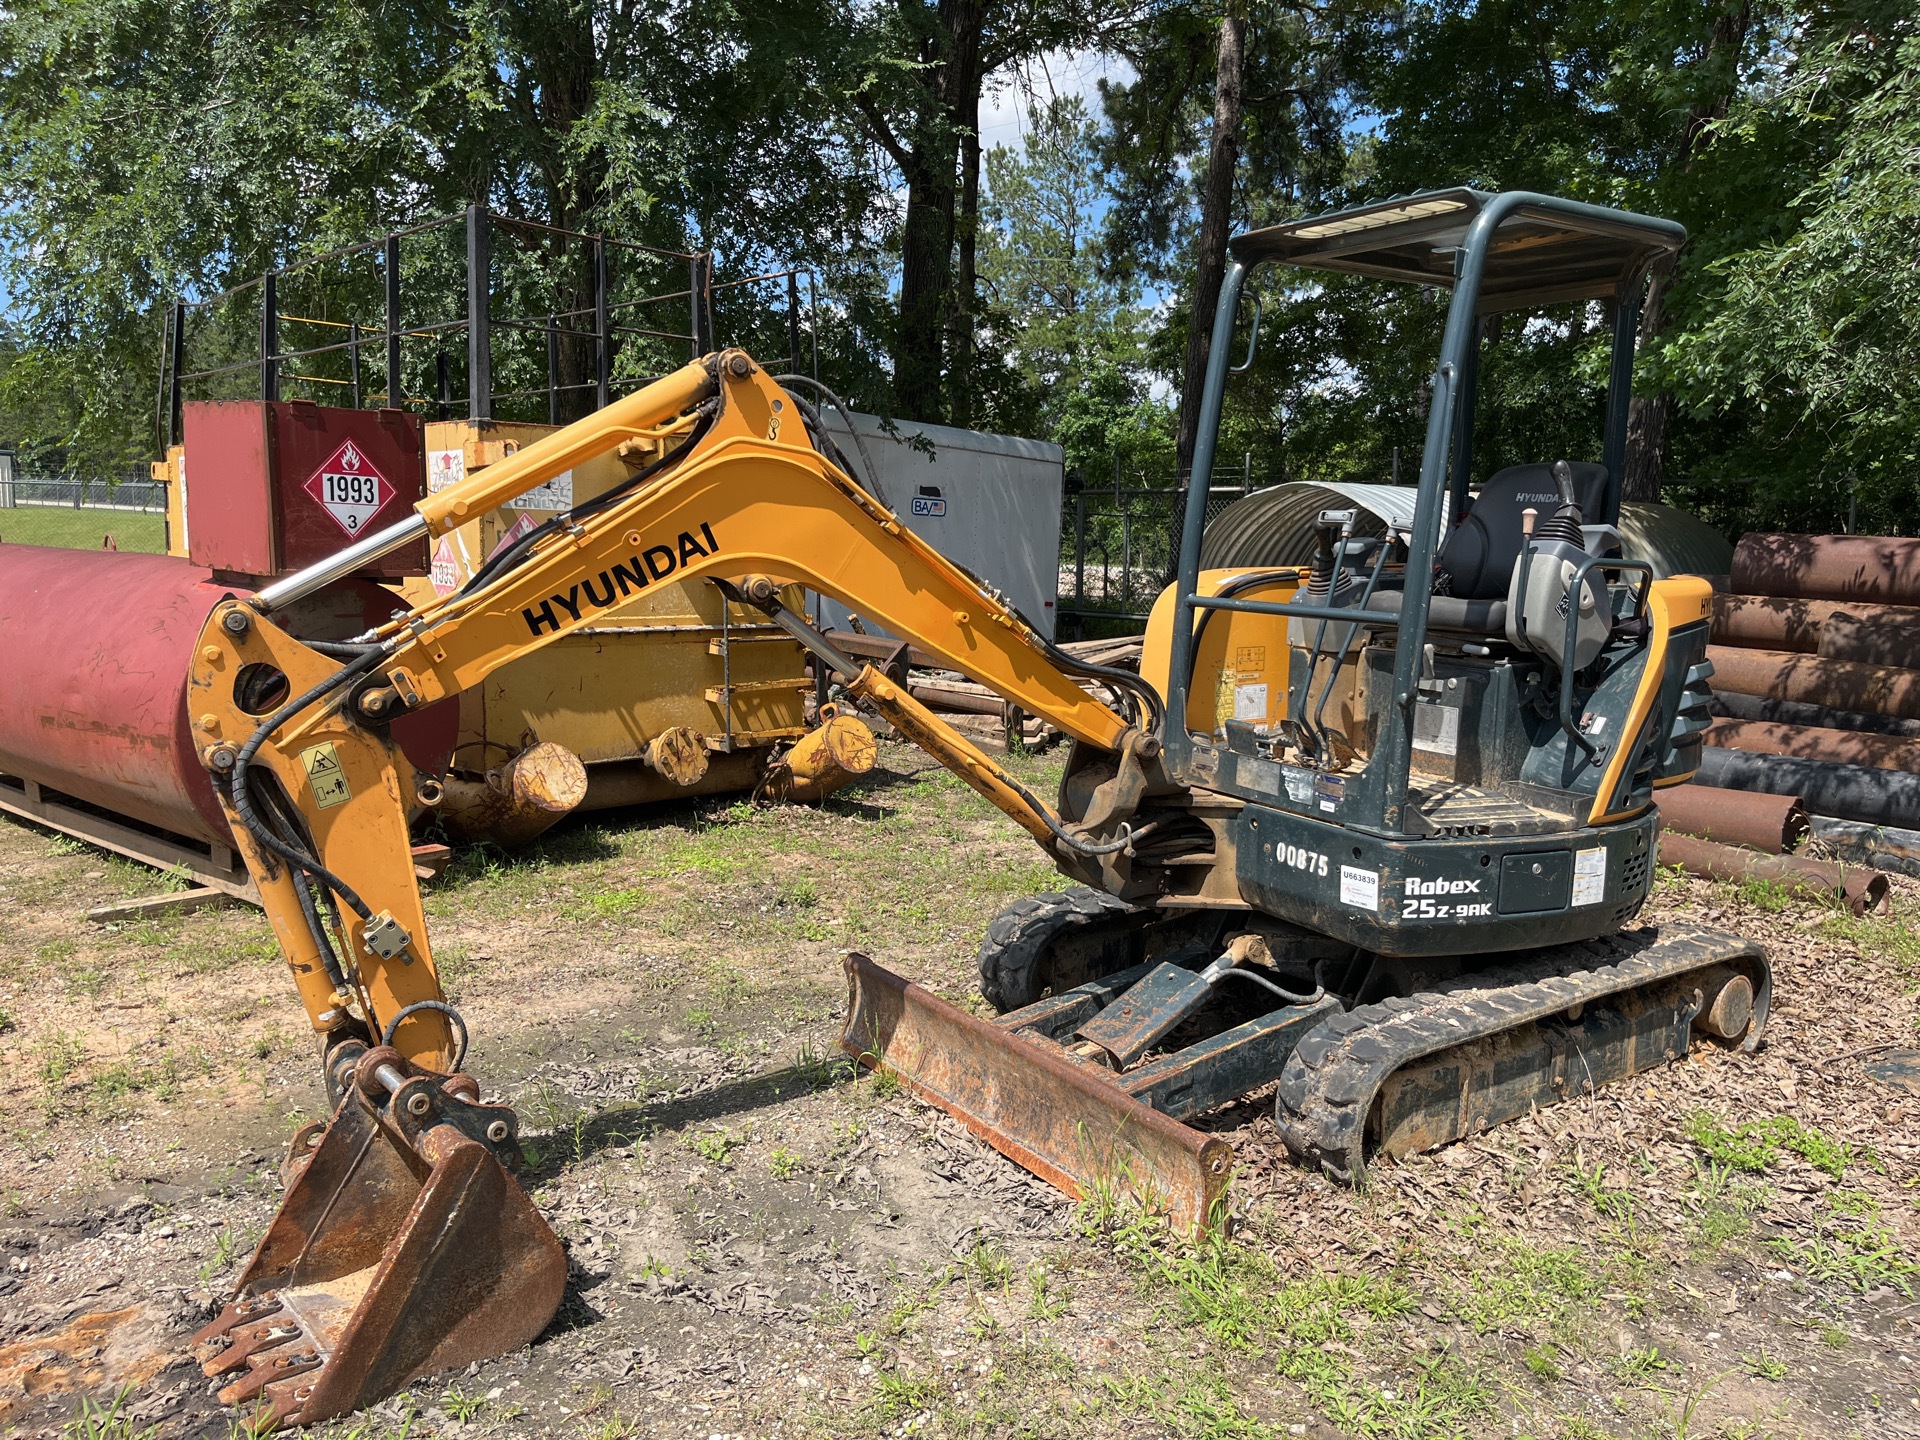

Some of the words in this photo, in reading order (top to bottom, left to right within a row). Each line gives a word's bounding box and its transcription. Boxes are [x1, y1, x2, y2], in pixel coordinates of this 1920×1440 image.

[326, 475, 375, 504] 1993
[1515, 492, 1562, 503] HYUNDA
[514, 496, 561, 509] ONLY
[347, 514, 358, 529] 3
[521, 521, 720, 637] HYUNDAI
[1276, 841, 1329, 877] 00875
[1343, 870, 1376, 885] U663839
[1404, 876, 1481, 896] Robex
